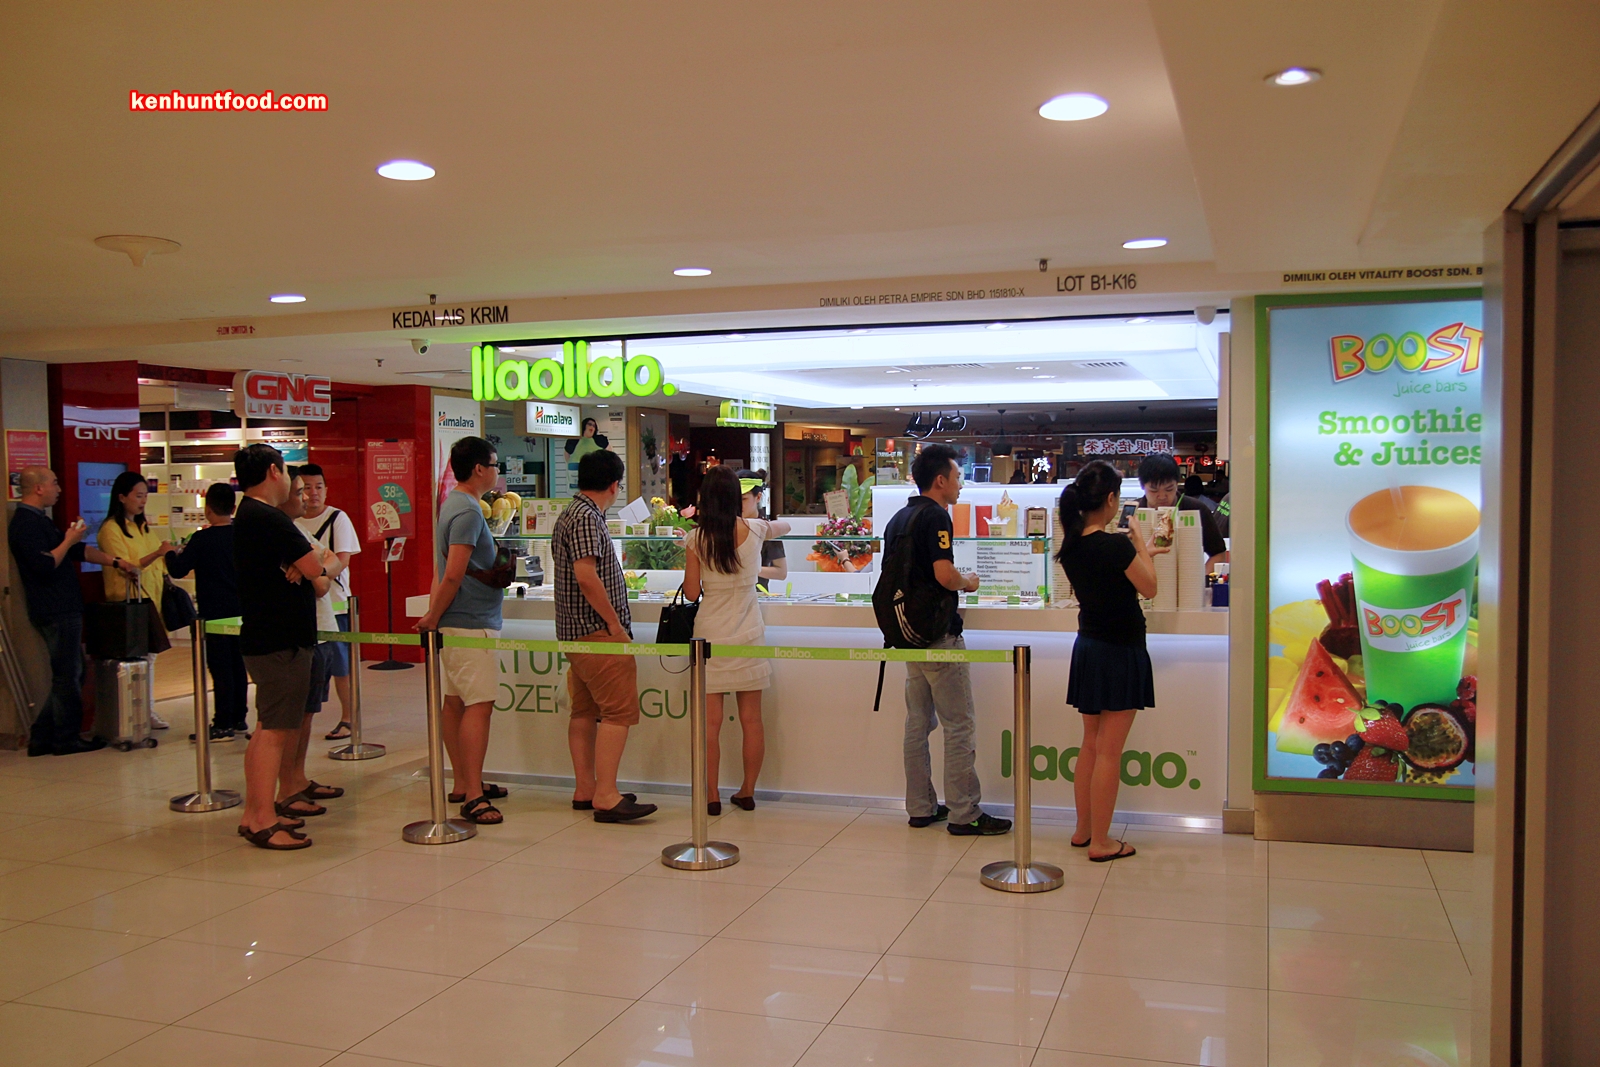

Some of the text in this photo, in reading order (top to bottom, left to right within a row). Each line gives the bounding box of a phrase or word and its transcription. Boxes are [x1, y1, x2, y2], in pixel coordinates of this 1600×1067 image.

[1056, 273, 1137, 292] LOT B1-K16
[1283, 272, 1326, 283] DIMILIKI
[1328, 271, 1357, 281] OLEH
[1359, 269, 1403, 280] VITALITY
[1406, 268, 1444, 278] BOOST
[1446, 267, 1473, 277] SDN.
[819, 297, 850, 307] DIMILIKI
[853, 295, 876, 306] OLEH
[878, 294, 909, 305] PETRA
[910, 292, 943, 303] EMPIRE
[945, 290, 965, 301] SDN
[967, 289, 986, 300] BHD
[392, 305, 509, 329] KEDAI AIS KRIM
[1330, 322, 1483, 382] BOOST
[471, 340, 677, 401] llaollao.
[247, 374, 330, 404] GNC
[1435, 379, 1468, 393] bars
[248, 403, 330, 417] LIVE WELL
[535, 406, 573, 426] Himalaya
[438, 411, 475, 428] Himalaya
[1318, 406, 1483, 435] Smoothie
[74, 426, 130, 441] GNC
[1333, 442, 1363, 466] &
[85, 478, 115, 487] GNC
[506, 476, 521, 484] are
[384, 485, 396, 498] 38
[376, 504, 386, 515] 28
[937, 530, 950, 550] 3
[1363, 599, 1462, 638] BOOST
[1431, 630, 1452, 644] bars
